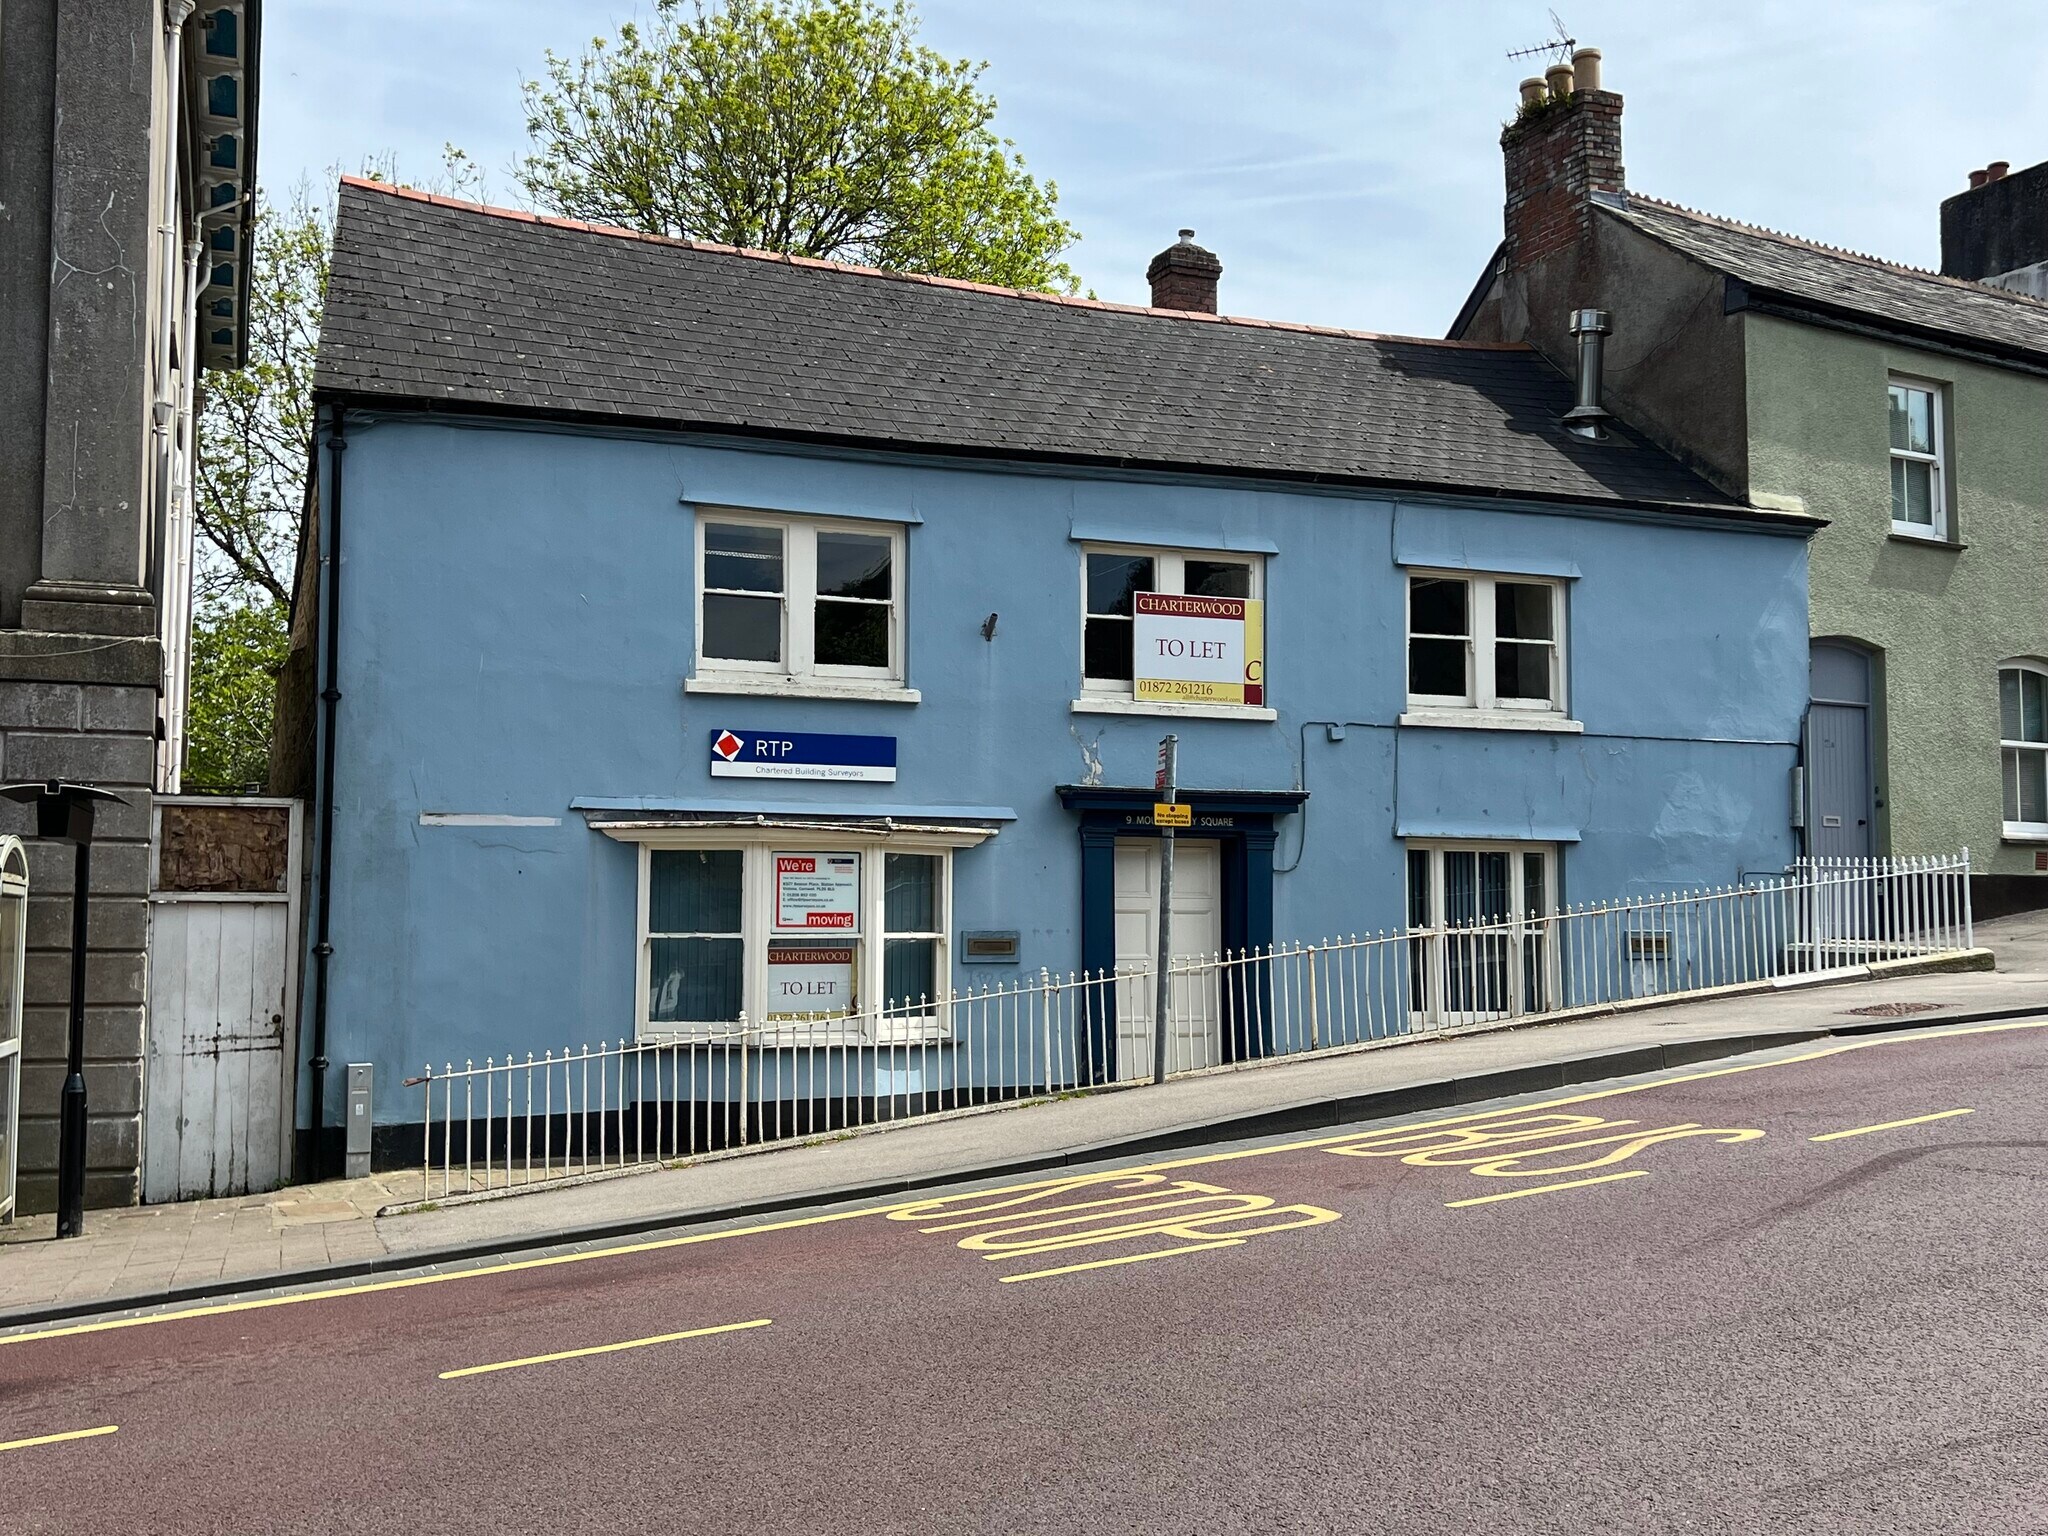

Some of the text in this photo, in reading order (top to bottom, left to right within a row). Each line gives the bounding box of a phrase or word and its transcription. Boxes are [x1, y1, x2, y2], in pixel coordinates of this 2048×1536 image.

[1139, 597, 1242, 616] CHARTERWOOD
[1155, 639, 1227, 659] TO LET
[1245, 660, 1262, 681] C
[1139, 681, 1213, 695] 01872 261216
[756, 740, 793, 757] RTP
[755, 765, 864, 778] Chartered Building Surveyors
[1126, 815, 1132, 825] 9
[1200, 817, 1234, 827] SQUARE
[779, 859, 813, 871] We're
[808, 914, 852, 927] moving
[768, 951, 850, 961] CHARTERWOOD
[780, 981, 837, 995] TO LET
[1322, 1114, 1766, 1177] BUS
[886, 1172, 1343, 1262] STOP
